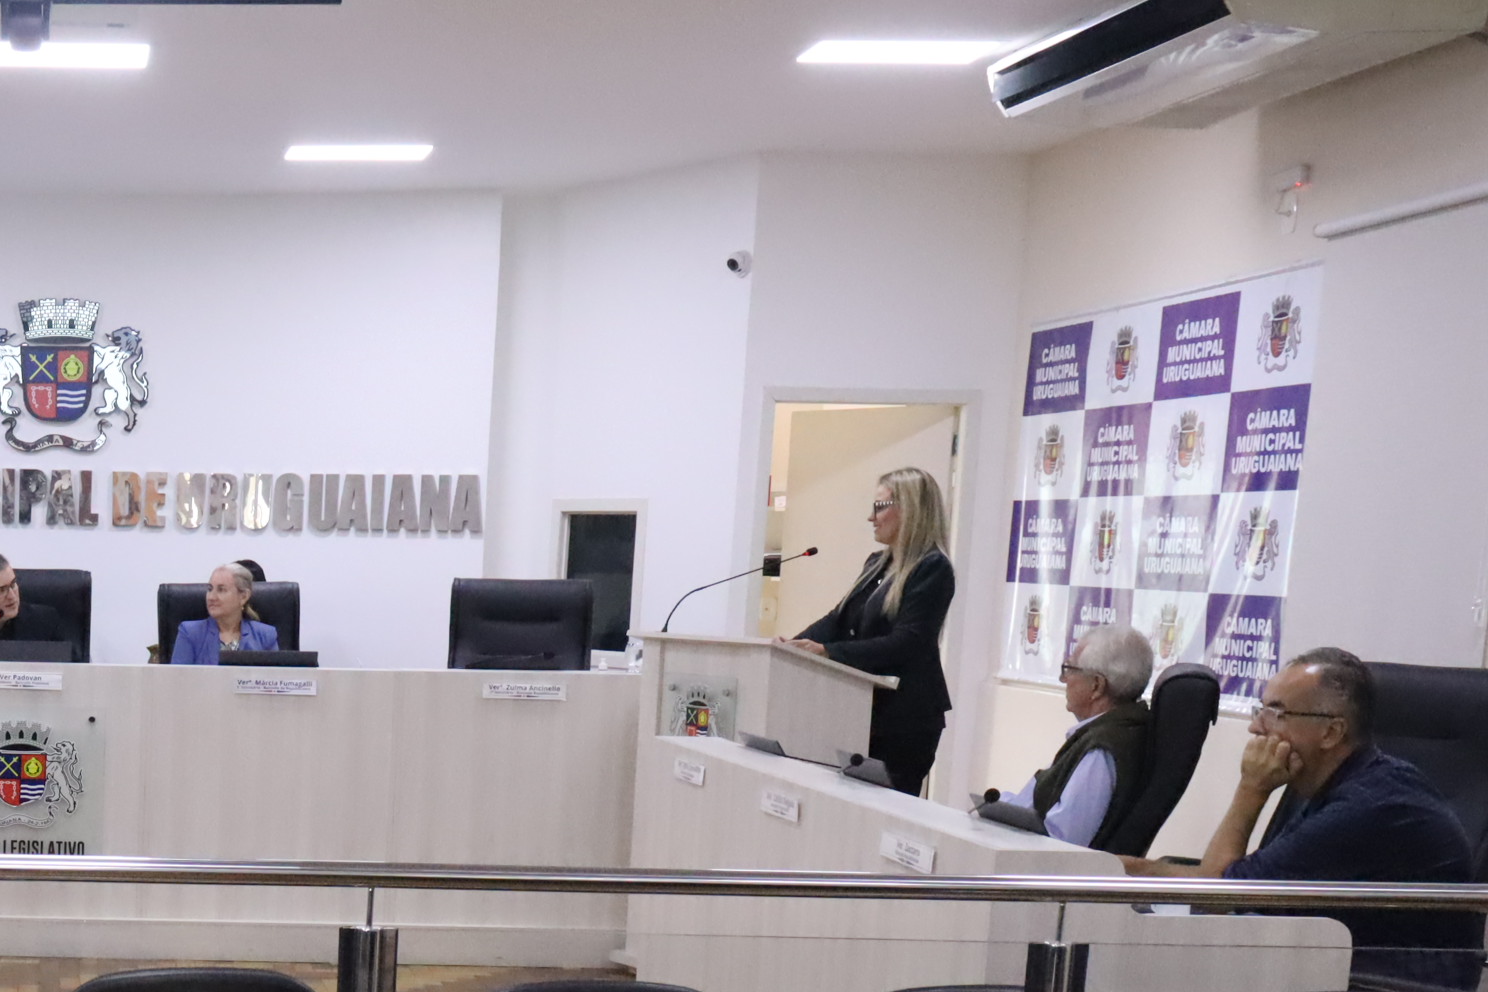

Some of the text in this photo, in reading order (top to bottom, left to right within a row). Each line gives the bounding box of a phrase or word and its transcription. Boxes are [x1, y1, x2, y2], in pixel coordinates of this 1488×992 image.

[1175, 317, 1220, 341] CÂMARA
[1042, 343, 1076, 364] CÂMARA
[1166, 338, 1225, 364] MUNICIPAL
[1035, 362, 1079, 384] MUNICIPAL
[1162, 359, 1225, 384] URUGUAIANA
[1033, 380, 1080, 401] URUGUAIANA
[1246, 408, 1296, 430] CÂMARA
[1097, 424, 1134, 443] CÂMARA
[1235, 431, 1302, 453] MUNICIPAL
[1090, 444, 1139, 464] MUNICIPAL
[1231, 453, 1303, 474] URUGUAIANA
[1087, 463, 1139, 482] URUGUAIANA
[112, 471, 168, 528] DE
[176, 472, 483, 532] URUGUAIANA
[1027, 515, 1064, 533] CÂMARA
[1156, 513, 1200, 533] CÂMARA
[1021, 536, 1067, 553] MUNICIPAL
[1147, 537, 1204, 555] MUNICIPAL
[1144, 556, 1204, 575] URUGUAIANA
[1080, 603, 1117, 624] CÂMARA
[1224, 613, 1272, 637] CÂMARA
[1213, 637, 1277, 660] MUNICIPAL
[13, 674, 42, 682] Padovan
[279, 680, 313, 689] Fumagalli
[506, 684, 528, 692] Zulma
[3, 839, 86, 856] LEGISLATIVO
